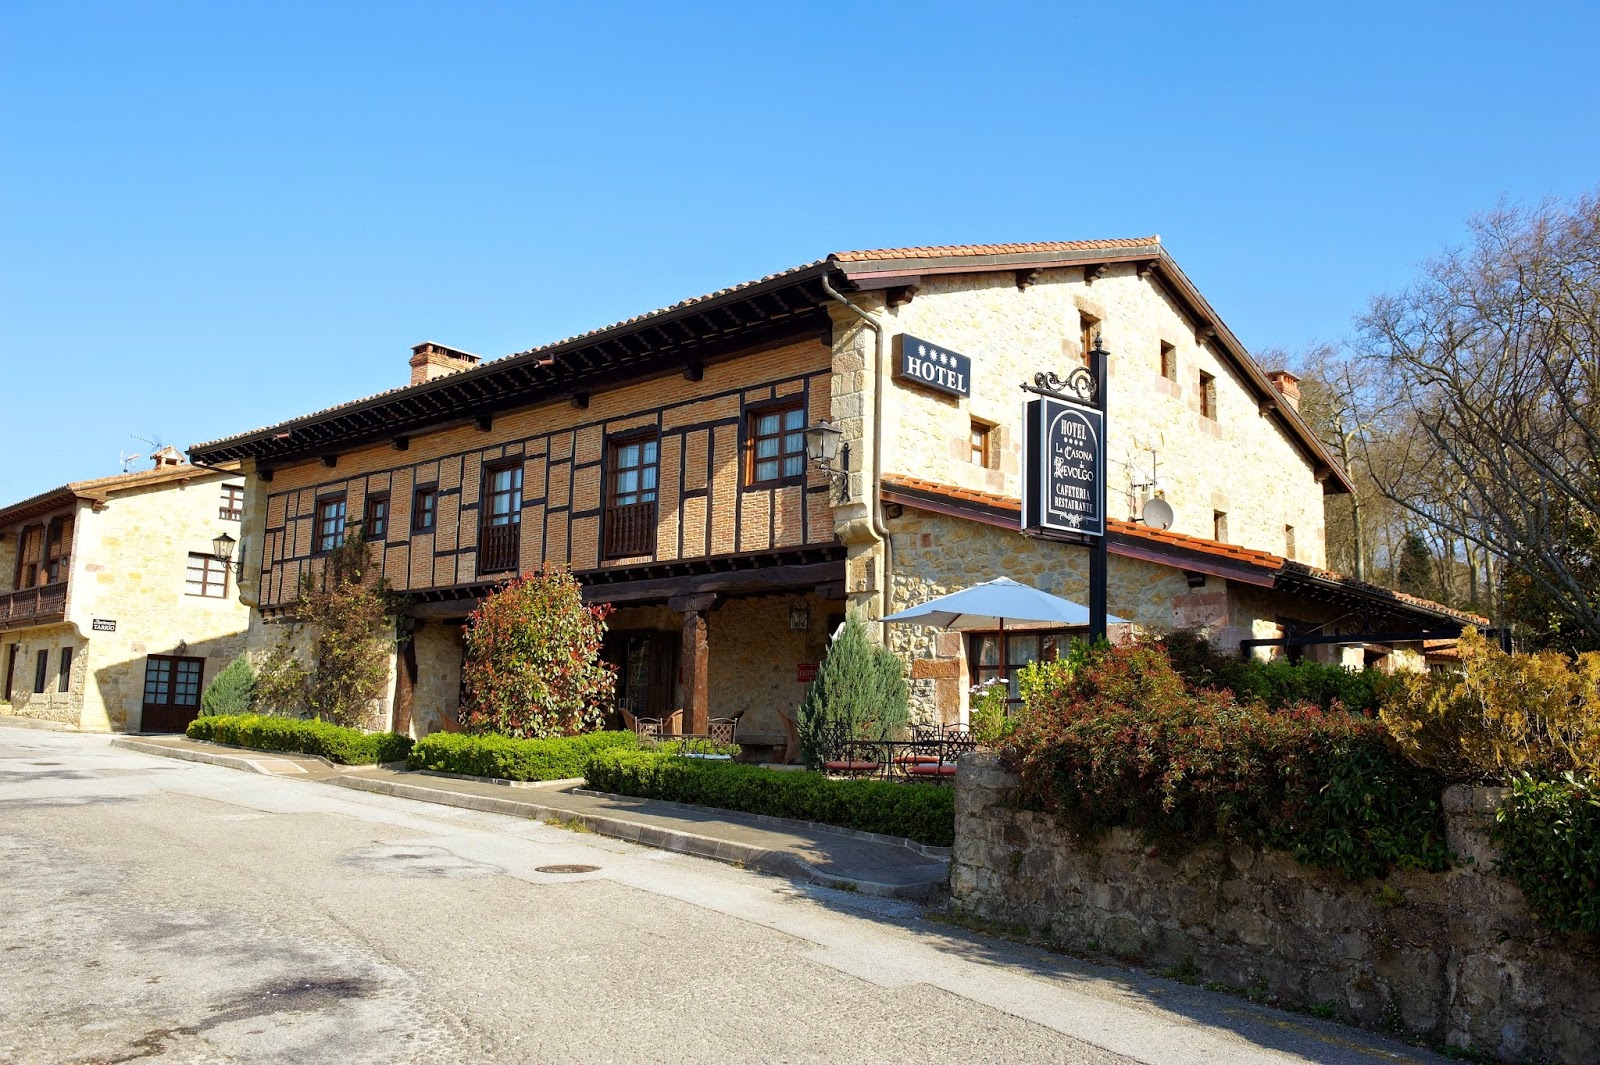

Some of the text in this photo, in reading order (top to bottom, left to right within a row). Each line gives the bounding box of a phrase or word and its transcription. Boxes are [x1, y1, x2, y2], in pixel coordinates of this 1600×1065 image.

[907, 355, 967, 393] HOTEL
[1061, 419, 1087, 440] HOTEL
[1056, 483, 1091, 501] CAFETERIA
